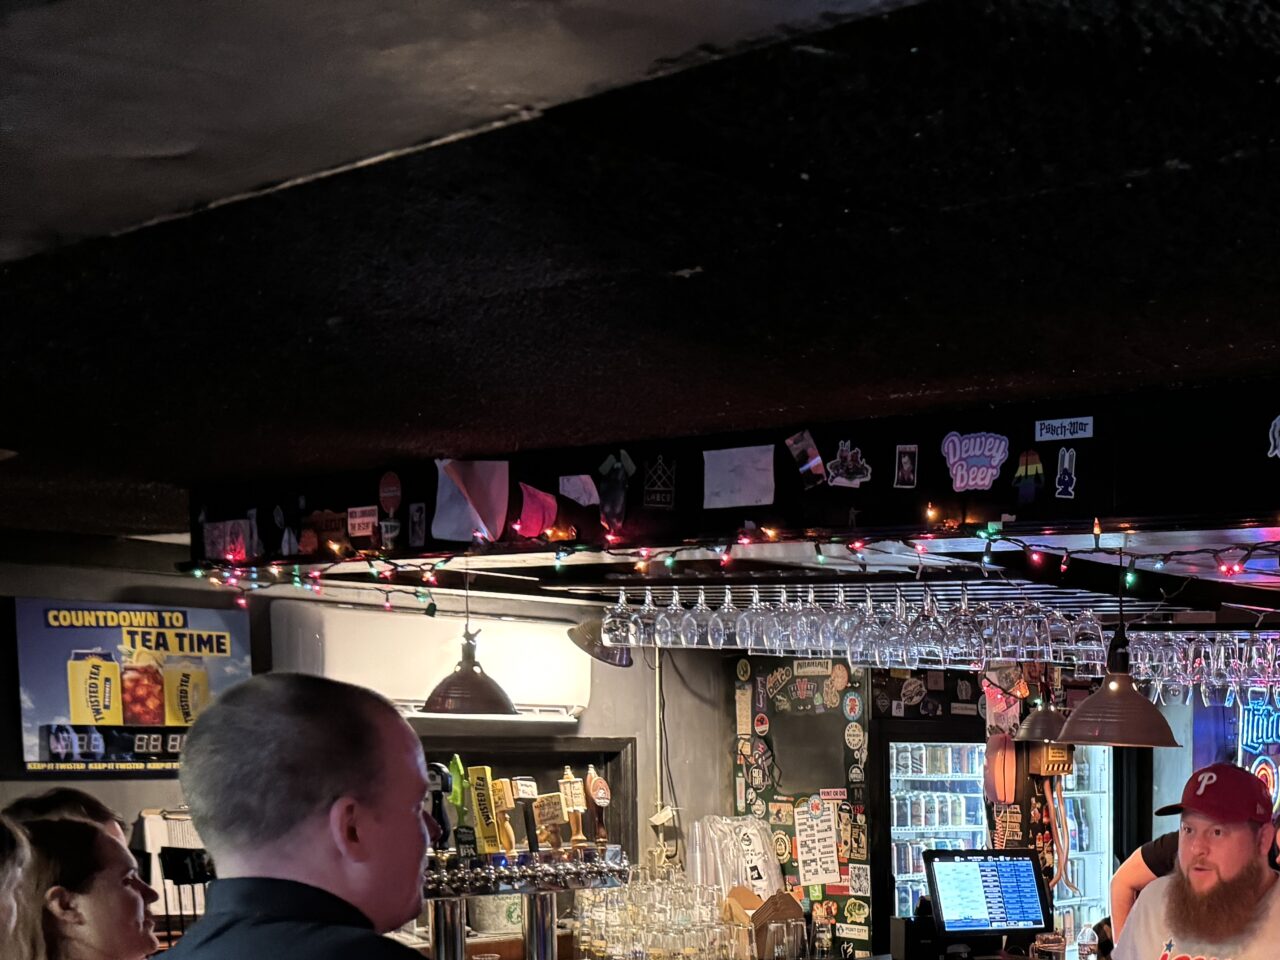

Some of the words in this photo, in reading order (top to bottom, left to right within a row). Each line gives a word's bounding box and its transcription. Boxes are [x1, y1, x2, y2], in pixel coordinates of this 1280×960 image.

[1039, 422, 1089, 437] Psych-War
[944, 436, 1006, 466] Dewey
[952, 461, 997, 488] Beer
[47, 610, 158, 628] COUNTDOWN
[162, 611, 183, 626] TO
[126, 630, 169, 651] TEA
[175, 632, 227, 654] TIME
[90, 664, 102, 681] TEA
[181, 672, 191, 690] TEA
[88, 682, 105, 722] TWISTED
[180, 690, 193, 723] TWISTED
[476, 776, 485, 791] TEA
[1196, 772, 1217, 795] P
[476, 791, 494, 827] TWISTED
